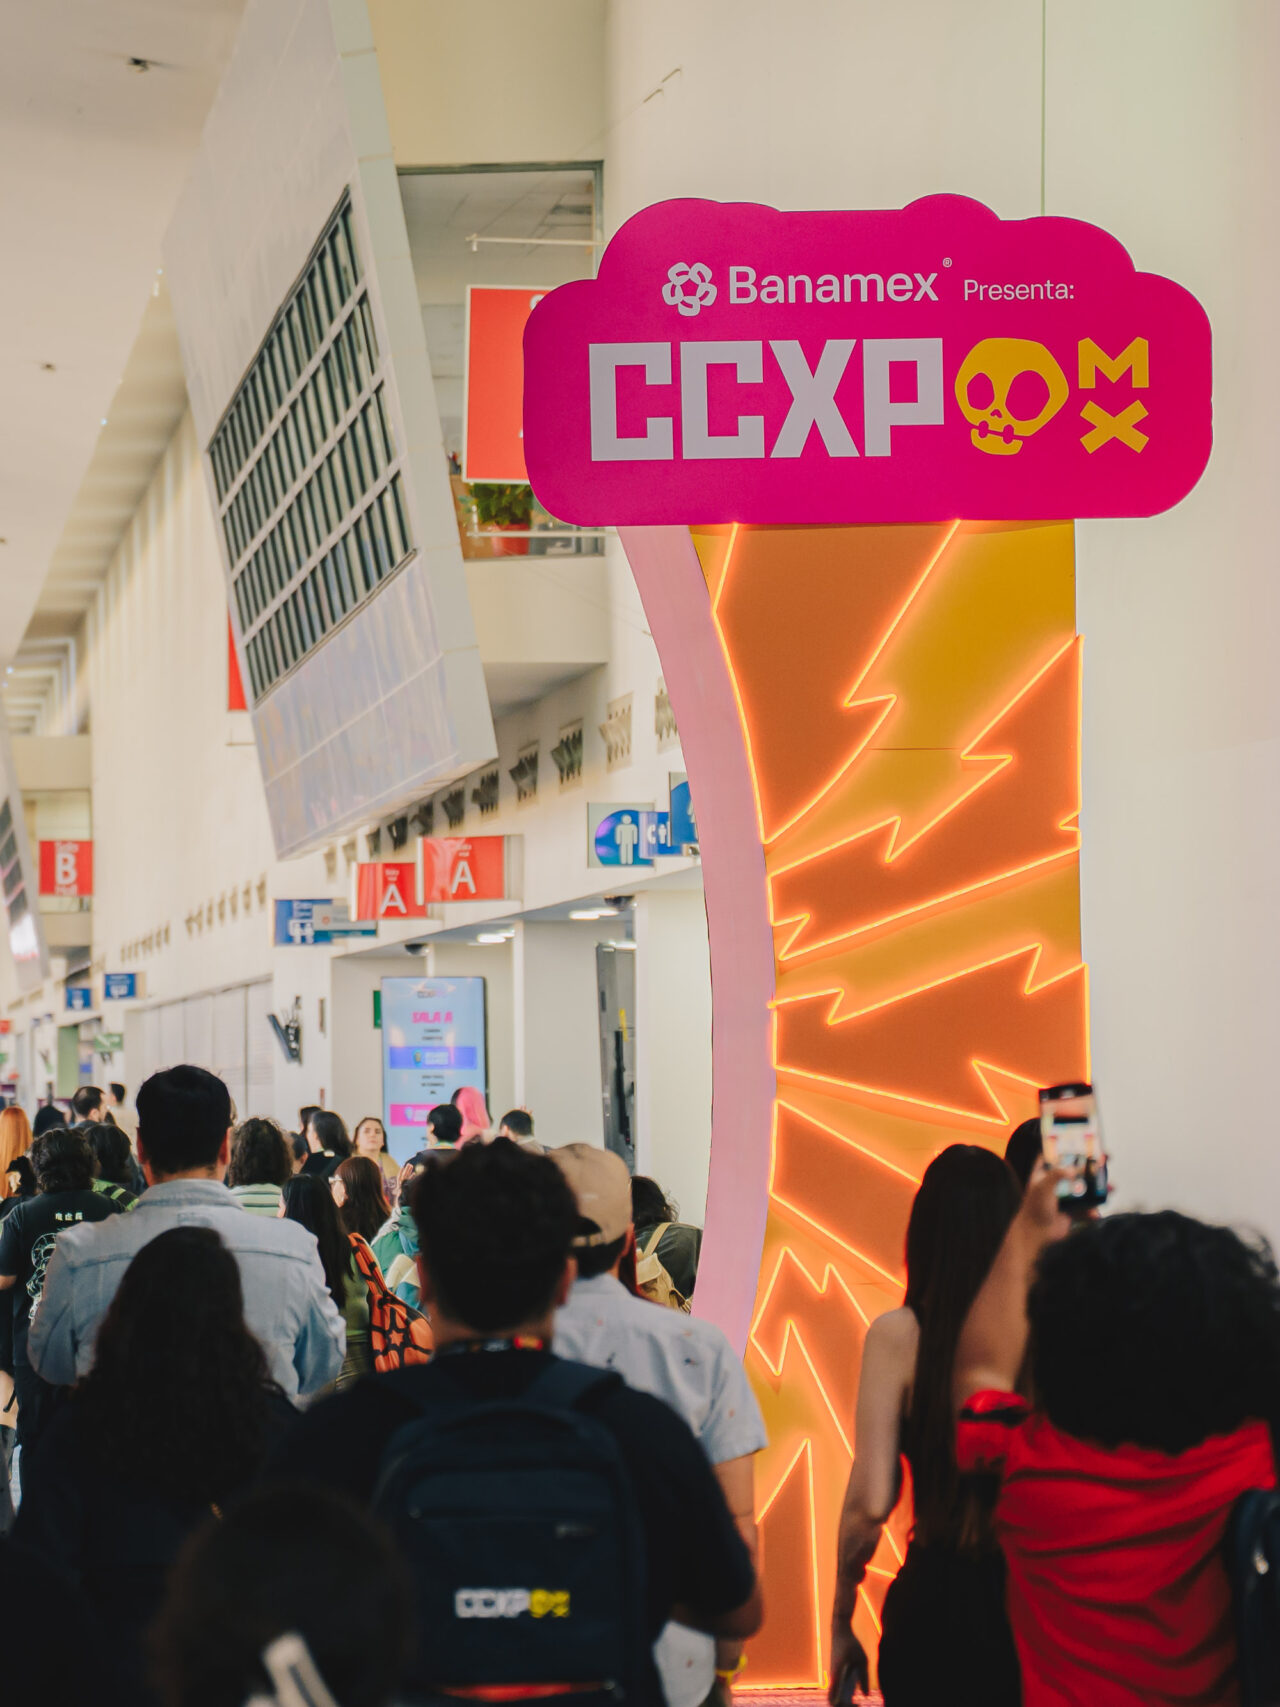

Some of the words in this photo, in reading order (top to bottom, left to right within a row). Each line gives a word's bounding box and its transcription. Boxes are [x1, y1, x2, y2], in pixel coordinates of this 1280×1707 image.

[729, 266, 939, 304] Banamex
[963, 279, 1075, 300] Presenta:
[588, 337, 945, 461] CCXP
[56, 853, 77, 884] B
[451, 860, 477, 894] A
[380, 883, 408, 915] A
